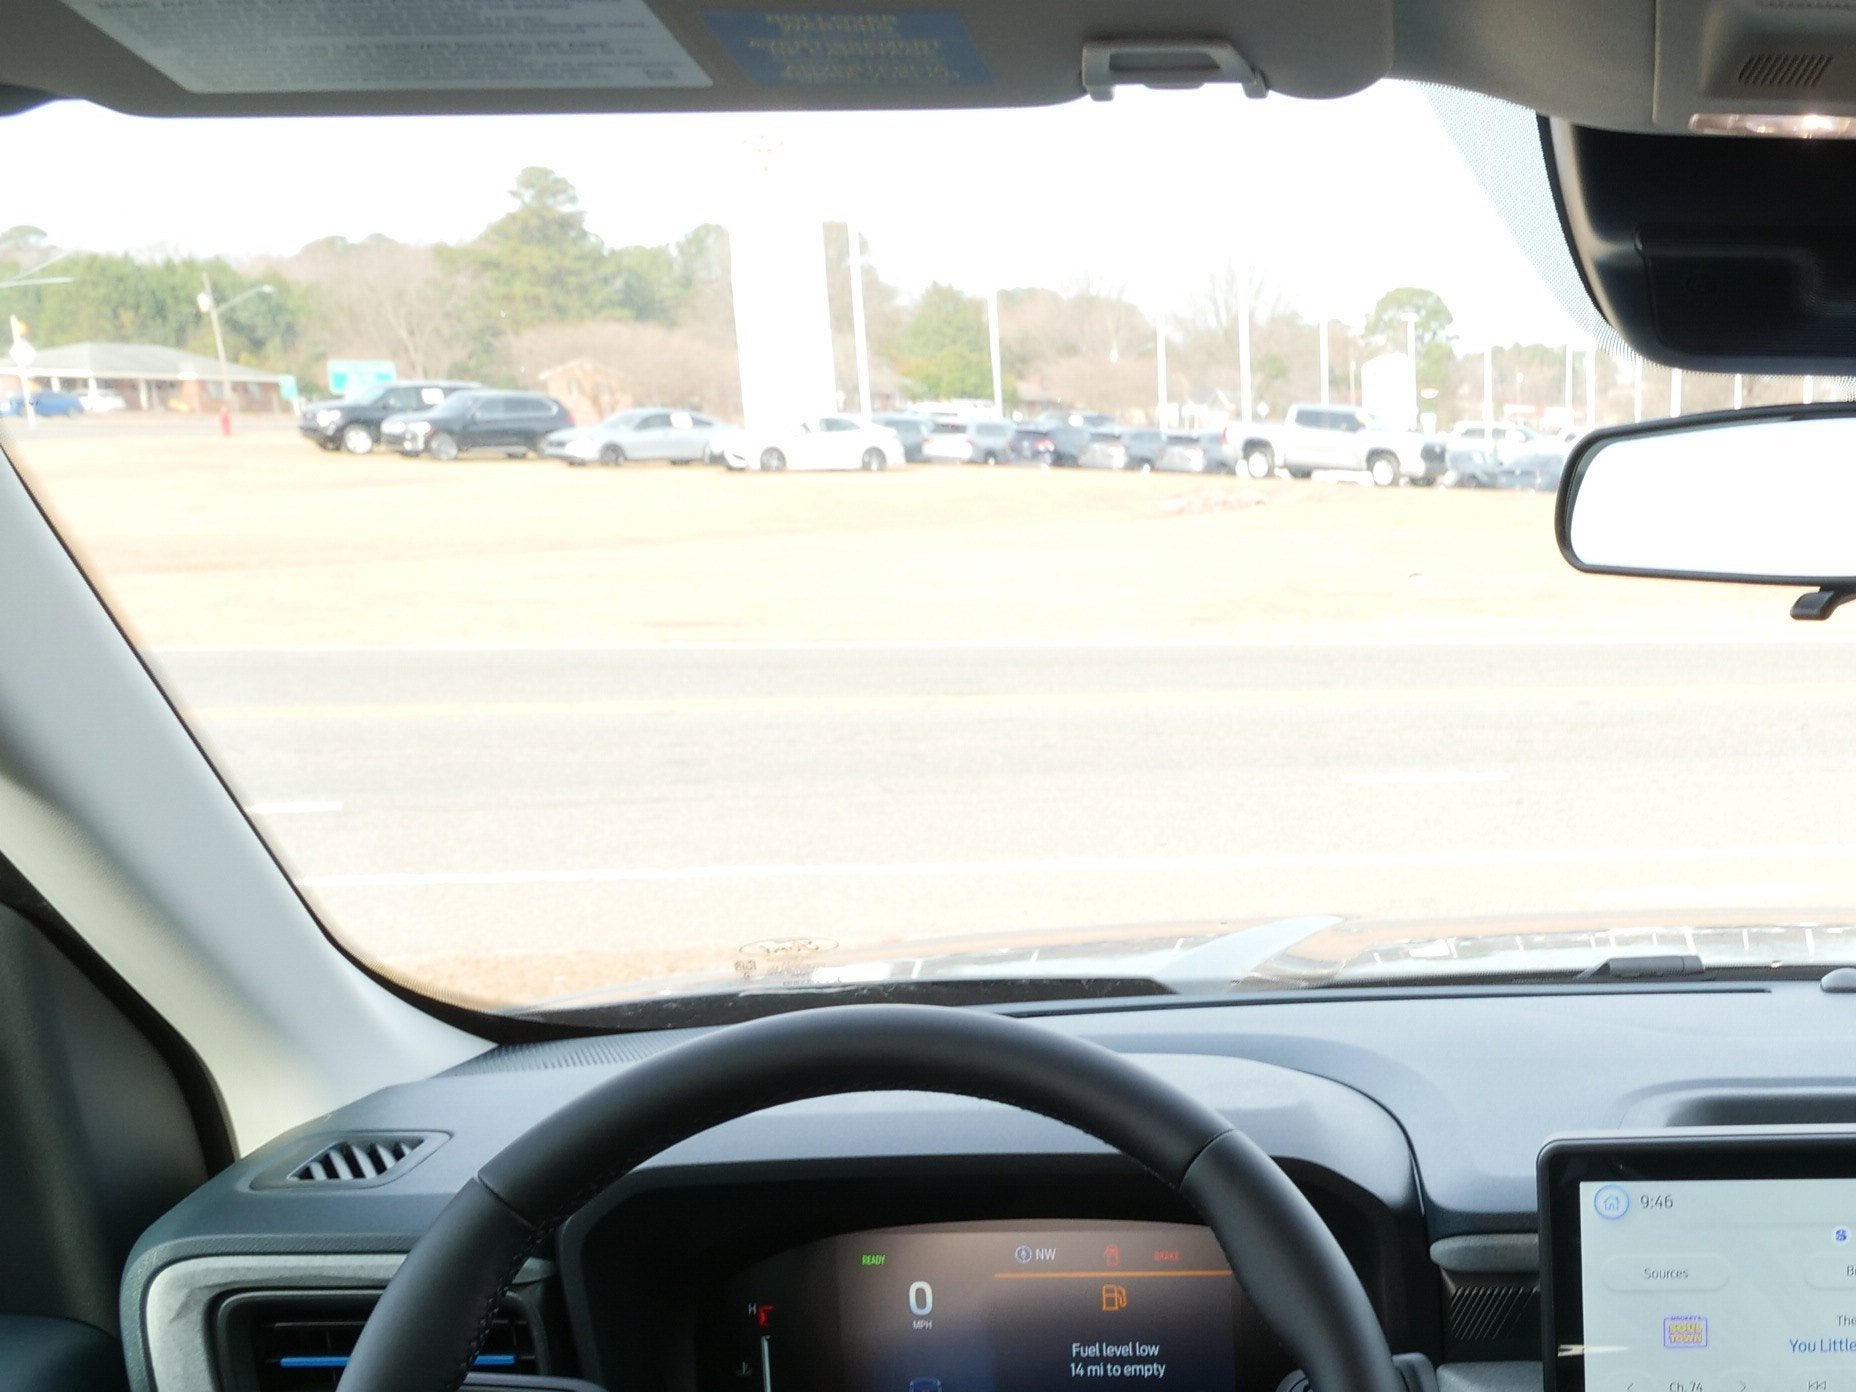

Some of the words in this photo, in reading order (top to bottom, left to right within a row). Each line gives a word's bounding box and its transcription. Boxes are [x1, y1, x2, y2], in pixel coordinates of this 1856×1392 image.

[1640, 1194, 1674, 1210] 9:46
[862, 1255, 886, 1265] READY
[1035, 1248, 1057, 1261] NW
[1643, 1267, 1689, 1280] Sources
[909, 1280, 933, 1317] 0
[912, 1319, 933, 1330] MPH
[1072, 1342, 1099, 1358] Fuel
[1102, 1341, 1133, 1357] level
[1136, 1341, 1160, 1357] low
[1789, 1338, 1817, 1353] You
[1070, 1362, 1084, 1377] 14
[1087, 1362, 1104, 1377] mi
[1107, 1362, 1121, 1377] to
[1123, 1362, 1166, 1379] empty
